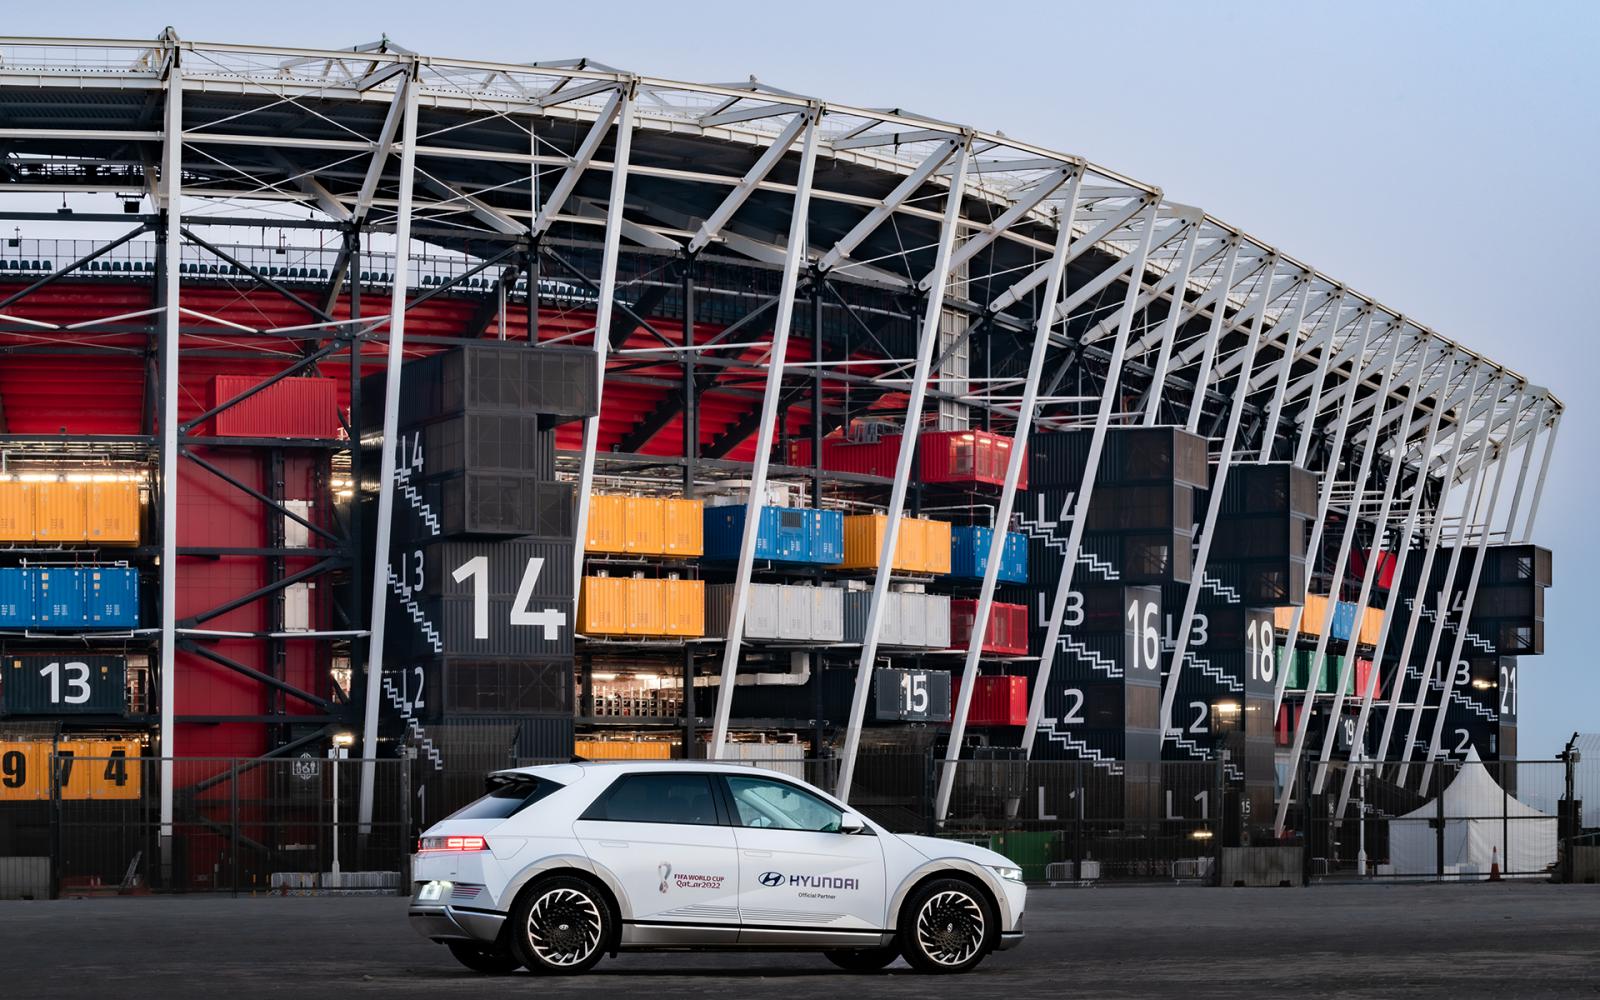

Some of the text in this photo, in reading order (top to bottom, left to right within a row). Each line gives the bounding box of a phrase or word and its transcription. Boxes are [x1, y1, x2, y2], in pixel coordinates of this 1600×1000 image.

[402, 431, 424, 476] L4
[1038, 491, 1080, 528] L4
[402, 550, 425, 596] L3
[451, 555, 567, 641] 14
[1038, 591, 1085, 628] L3
[1127, 599, 1159, 670] 16
[1165, 613, 1209, 647] L3
[1247, 619, 1274, 682] 18
[39, 662, 91, 704] 13
[402, 666, 425, 711] L2
[1436, 660, 1471, 687] L3
[1501, 666, 1517, 716] 21
[901, 674, 928, 712] 15
[1344, 719, 1355, 746] 19
[2, 750, 128, 788] 9 7 4
[1166, 790, 1209, 820] L1
[689, 874, 712, 882] WORLD
[789, 875, 859, 890] HYUNDAI
